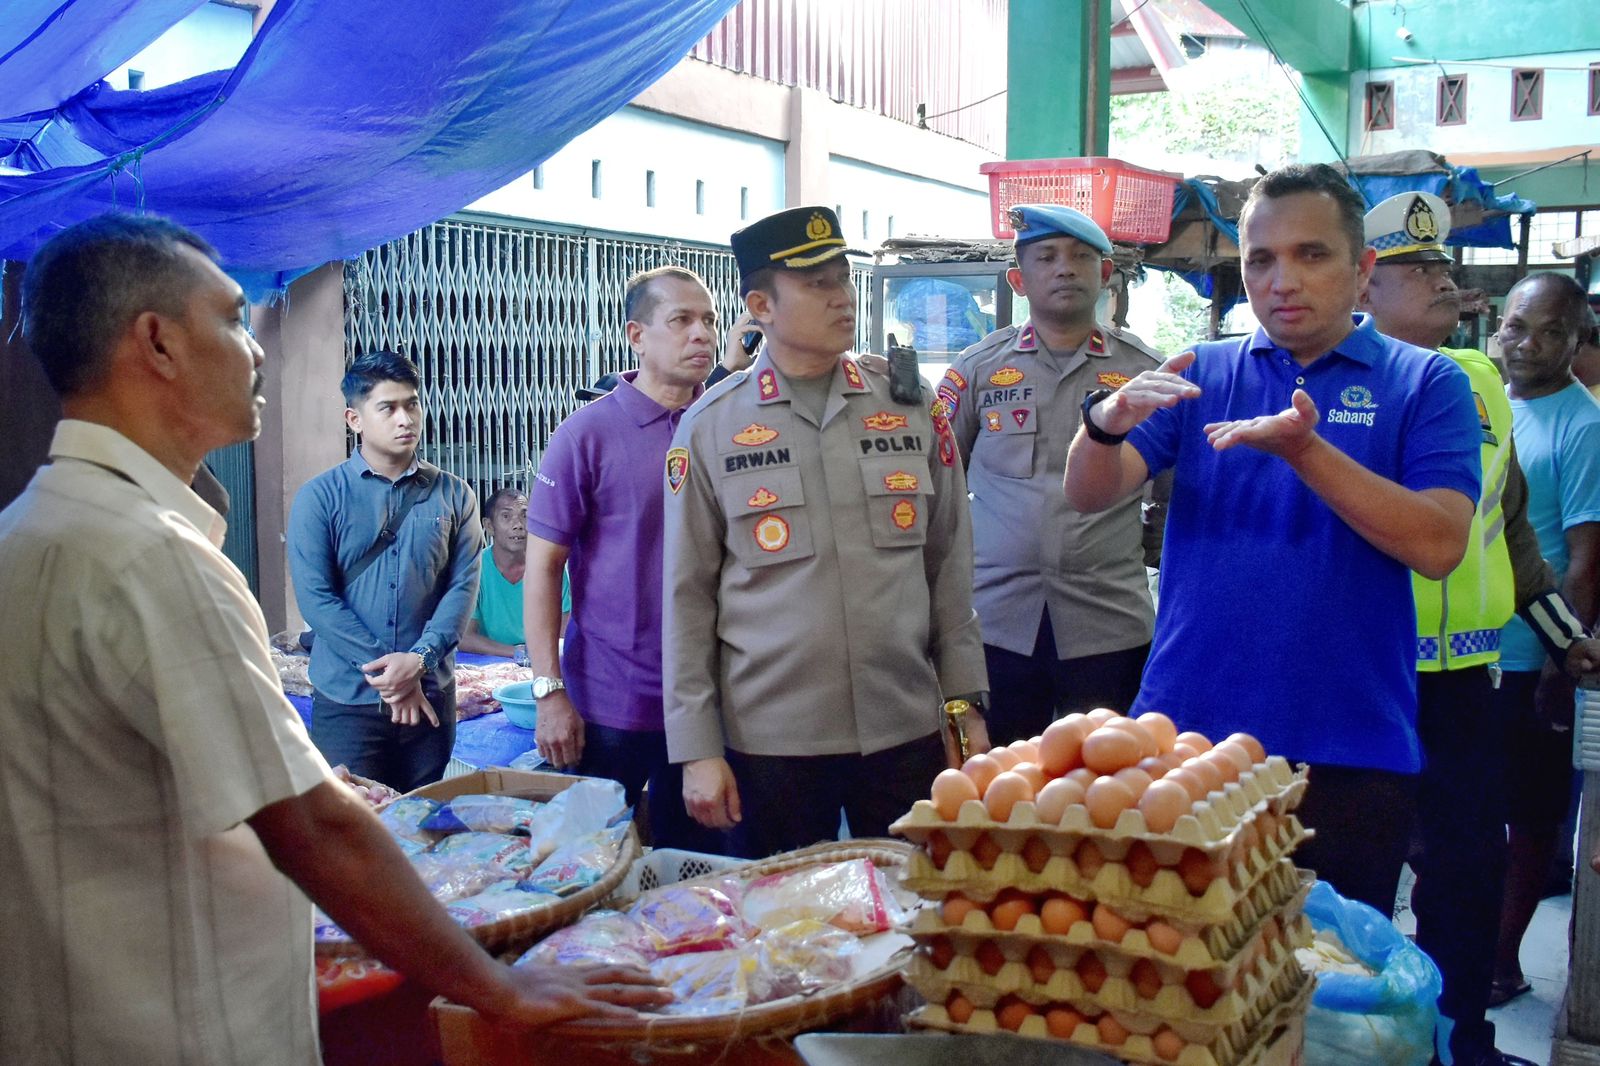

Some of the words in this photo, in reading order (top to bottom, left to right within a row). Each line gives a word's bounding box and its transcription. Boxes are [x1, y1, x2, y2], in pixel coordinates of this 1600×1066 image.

[1327, 408, 1376, 427] Sabang
[860, 435, 922, 455] POLRI
[725, 447, 790, 472] ERWAN
